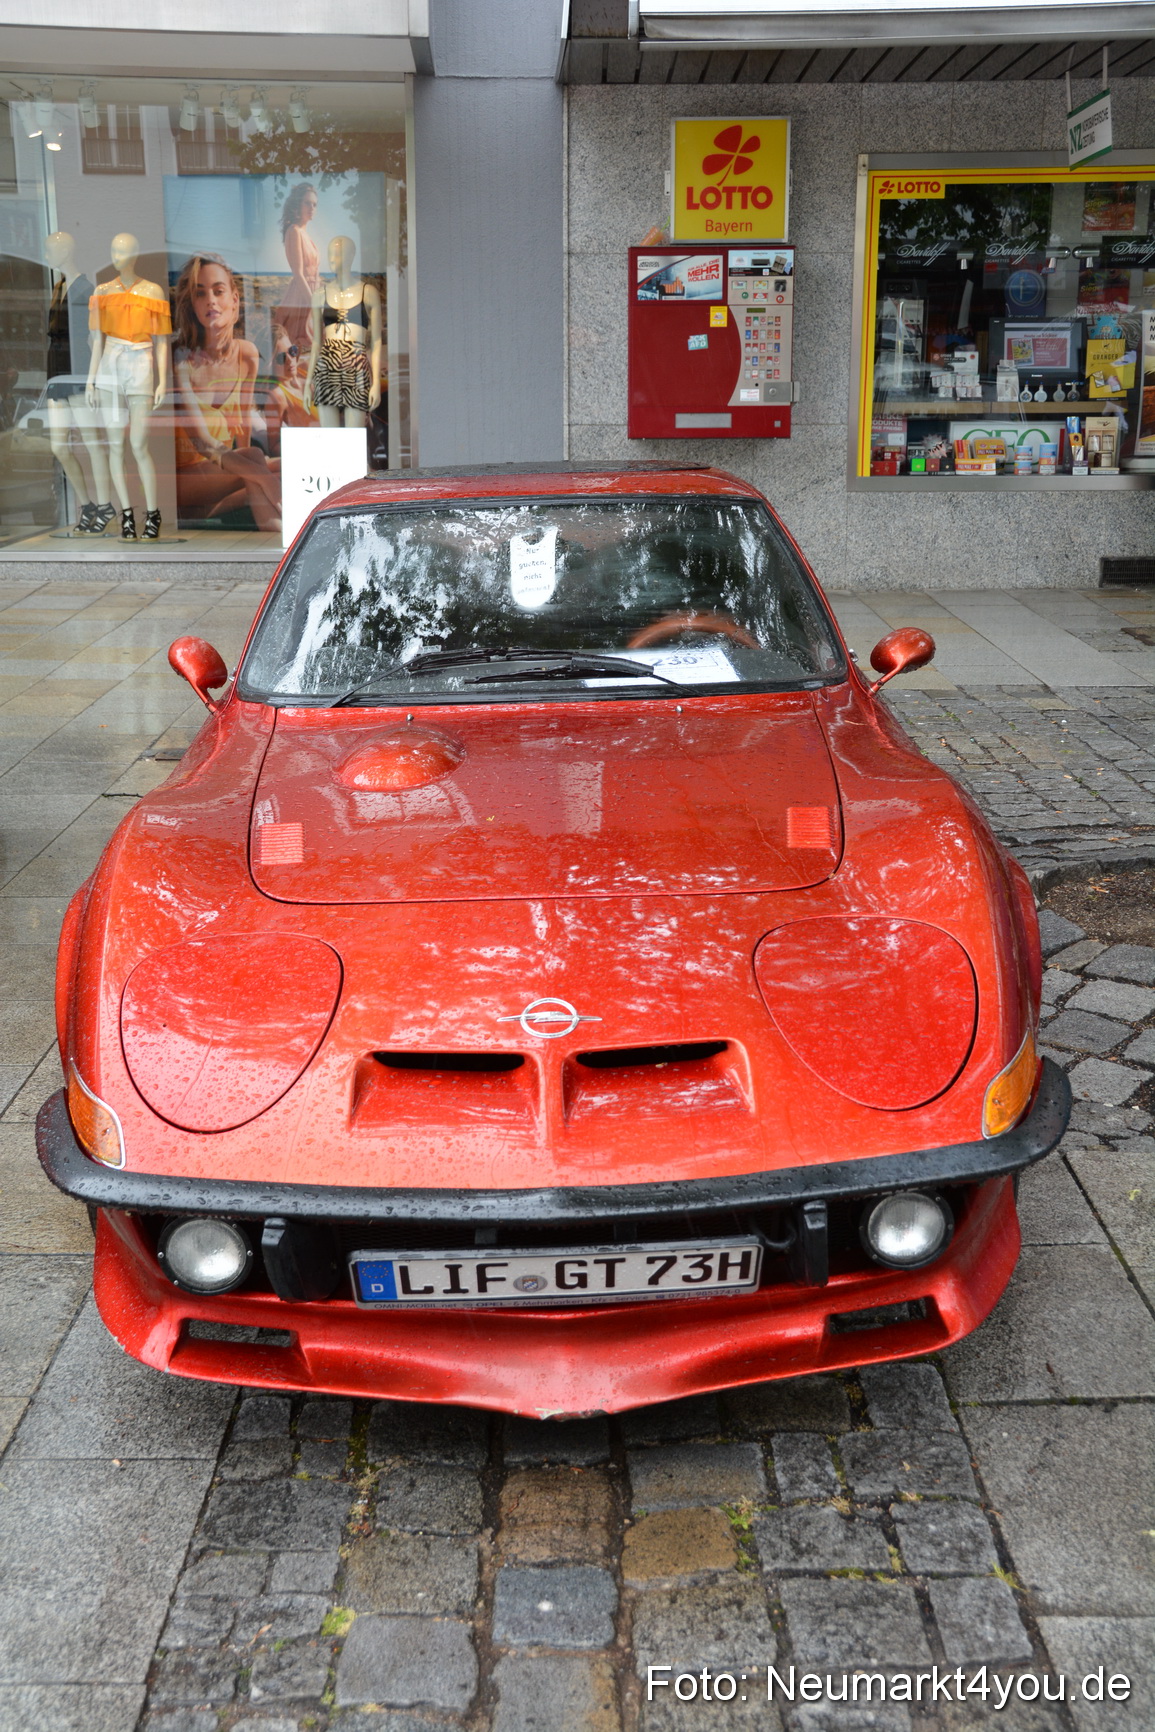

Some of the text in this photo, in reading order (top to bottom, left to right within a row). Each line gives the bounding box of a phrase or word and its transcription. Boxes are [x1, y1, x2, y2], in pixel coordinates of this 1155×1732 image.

[897, 181, 941, 193] LOTTO
[686, 185, 774, 211] LOTTO
[705, 219, 753, 236] Bayern
[896, 241, 951, 267] Davidoff
[984, 240, 1040, 265] Davidoff
[687, 263, 720, 278] MEHR
[687, 273, 720, 283] WOLLEN
[1092, 353, 1119, 361] GRANGER
[399, 1250, 753, 1296] LIF GT 73H
[371, 1283, 384, 1293] D
